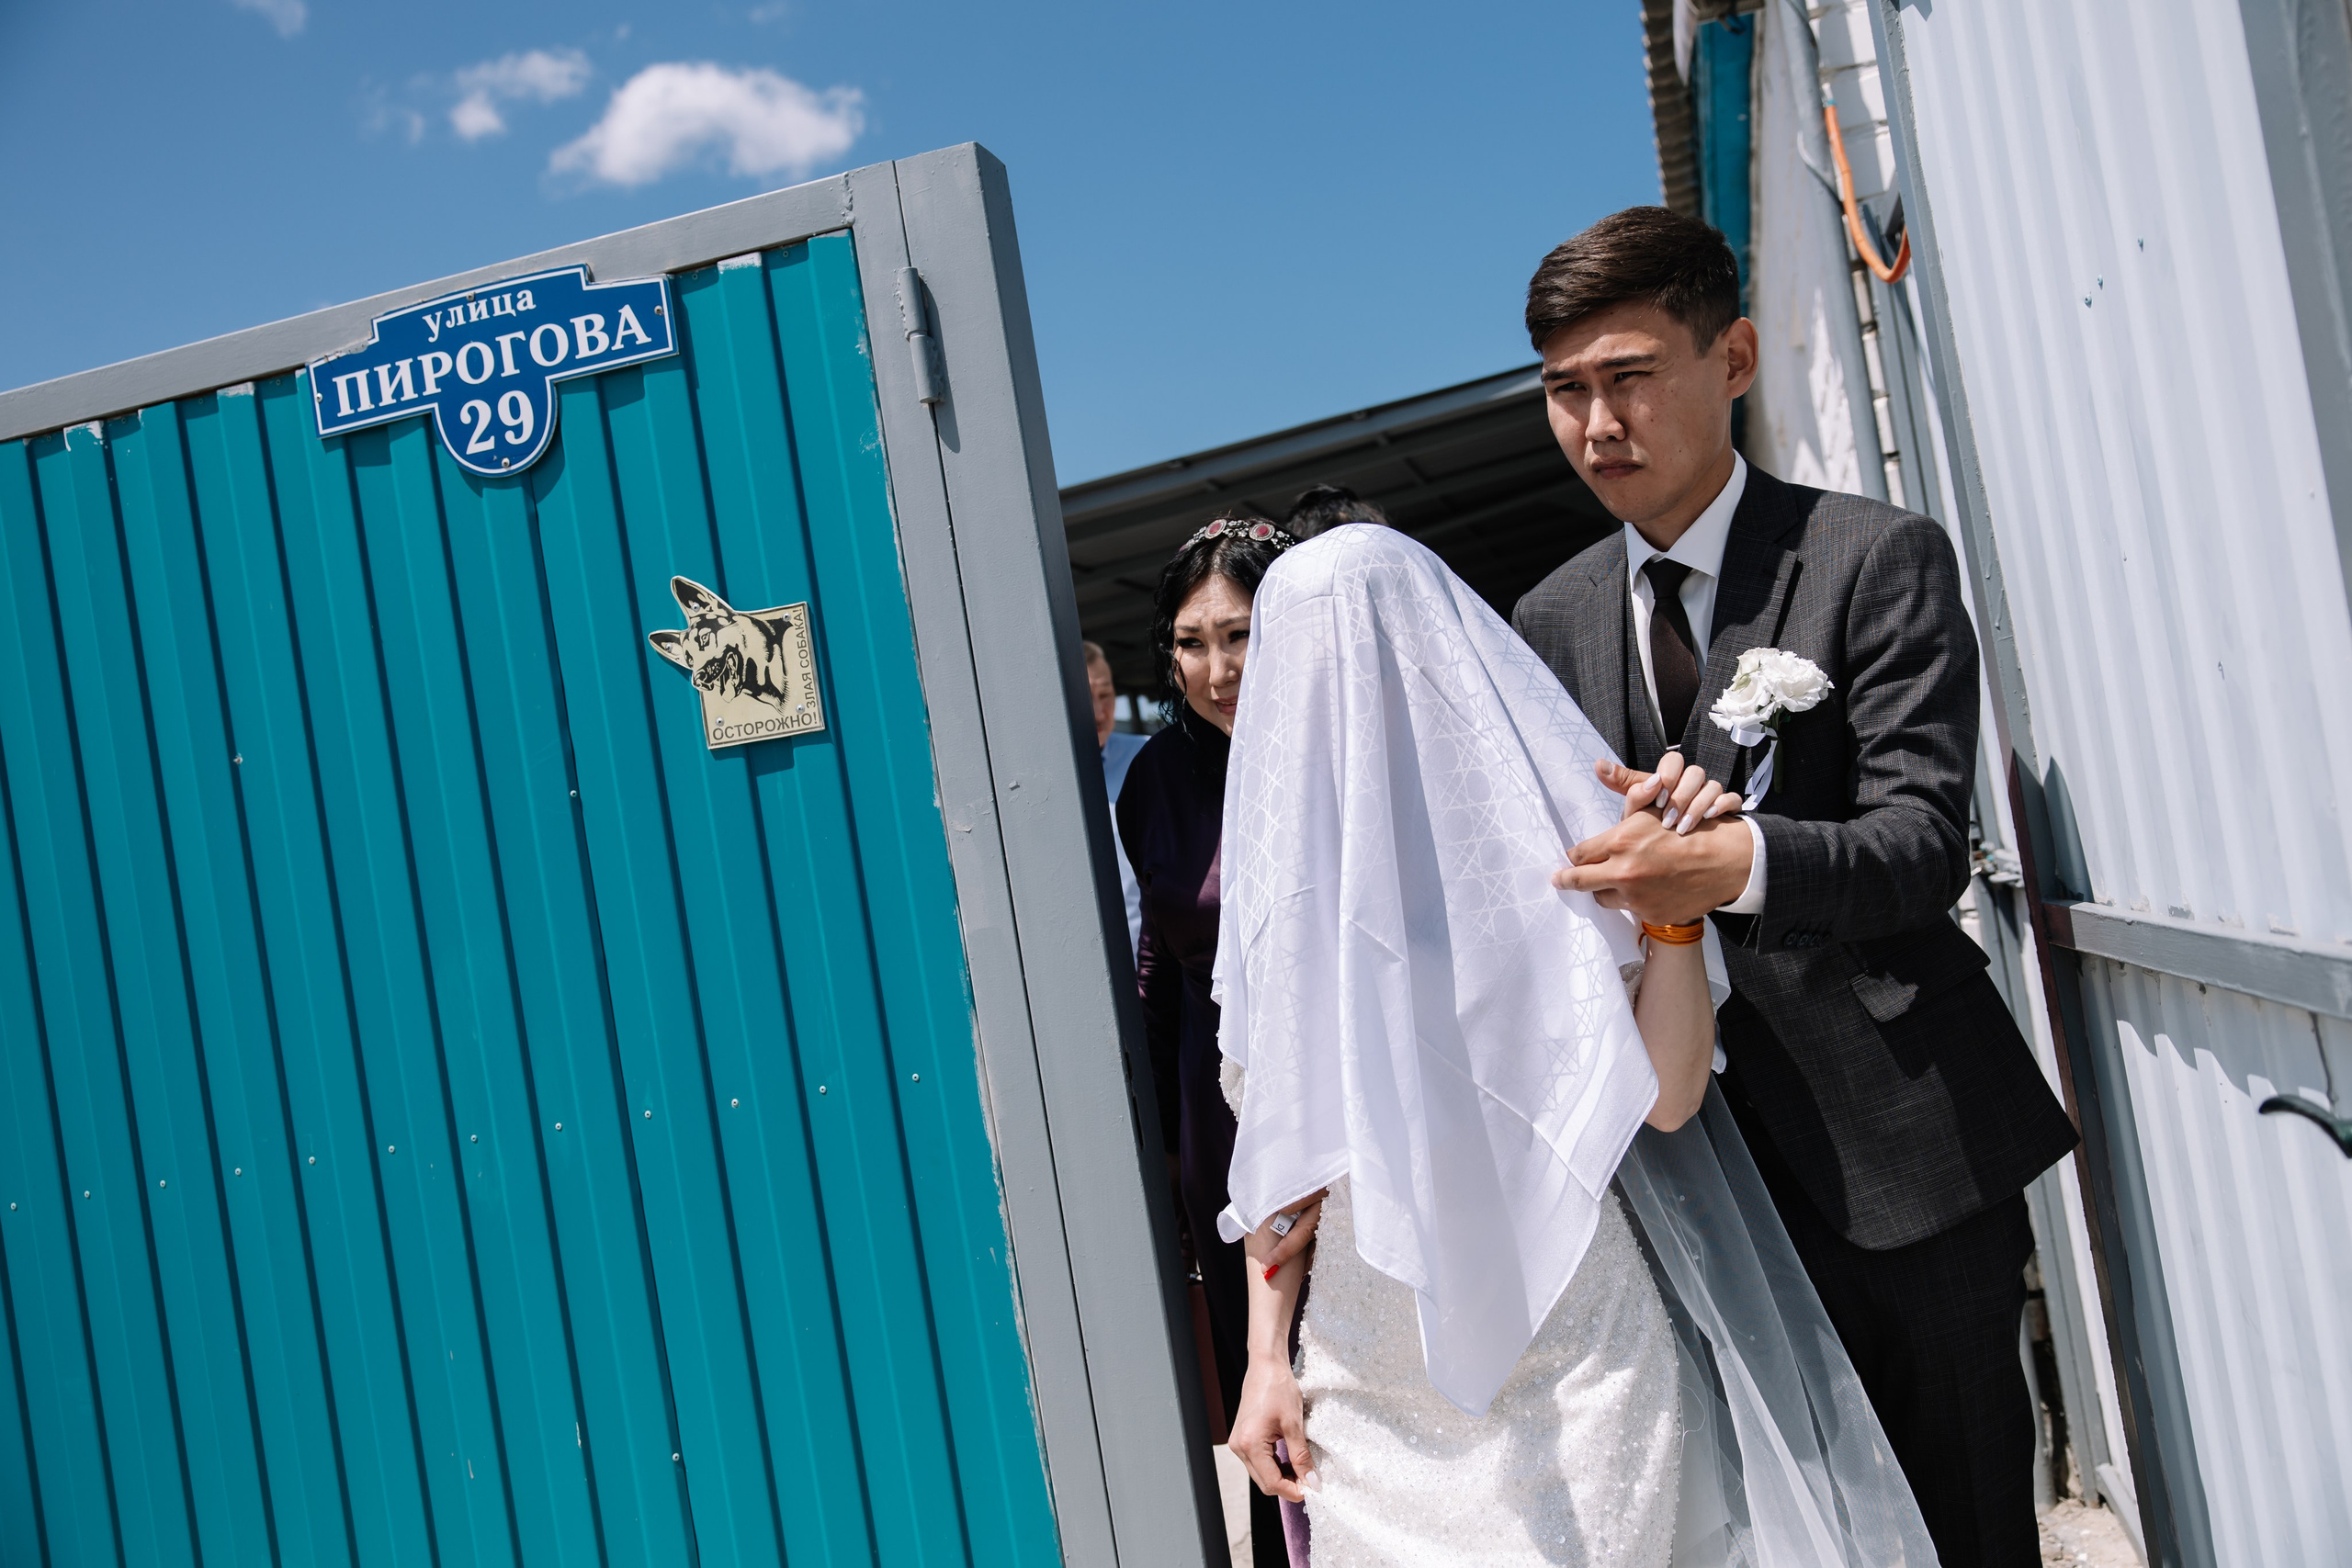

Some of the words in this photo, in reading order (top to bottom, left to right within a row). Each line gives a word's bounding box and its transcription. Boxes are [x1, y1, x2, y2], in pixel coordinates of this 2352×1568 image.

[422, 289, 537, 343] улица
[332, 304, 651, 417] ПИРОГОВА
[459, 389, 534, 455] 29
[792, 607, 809, 668] СОБАКА!
[801, 671, 816, 708] ЗЛАЯ
[713, 711, 818, 740] ОСТОРОЖНО!
